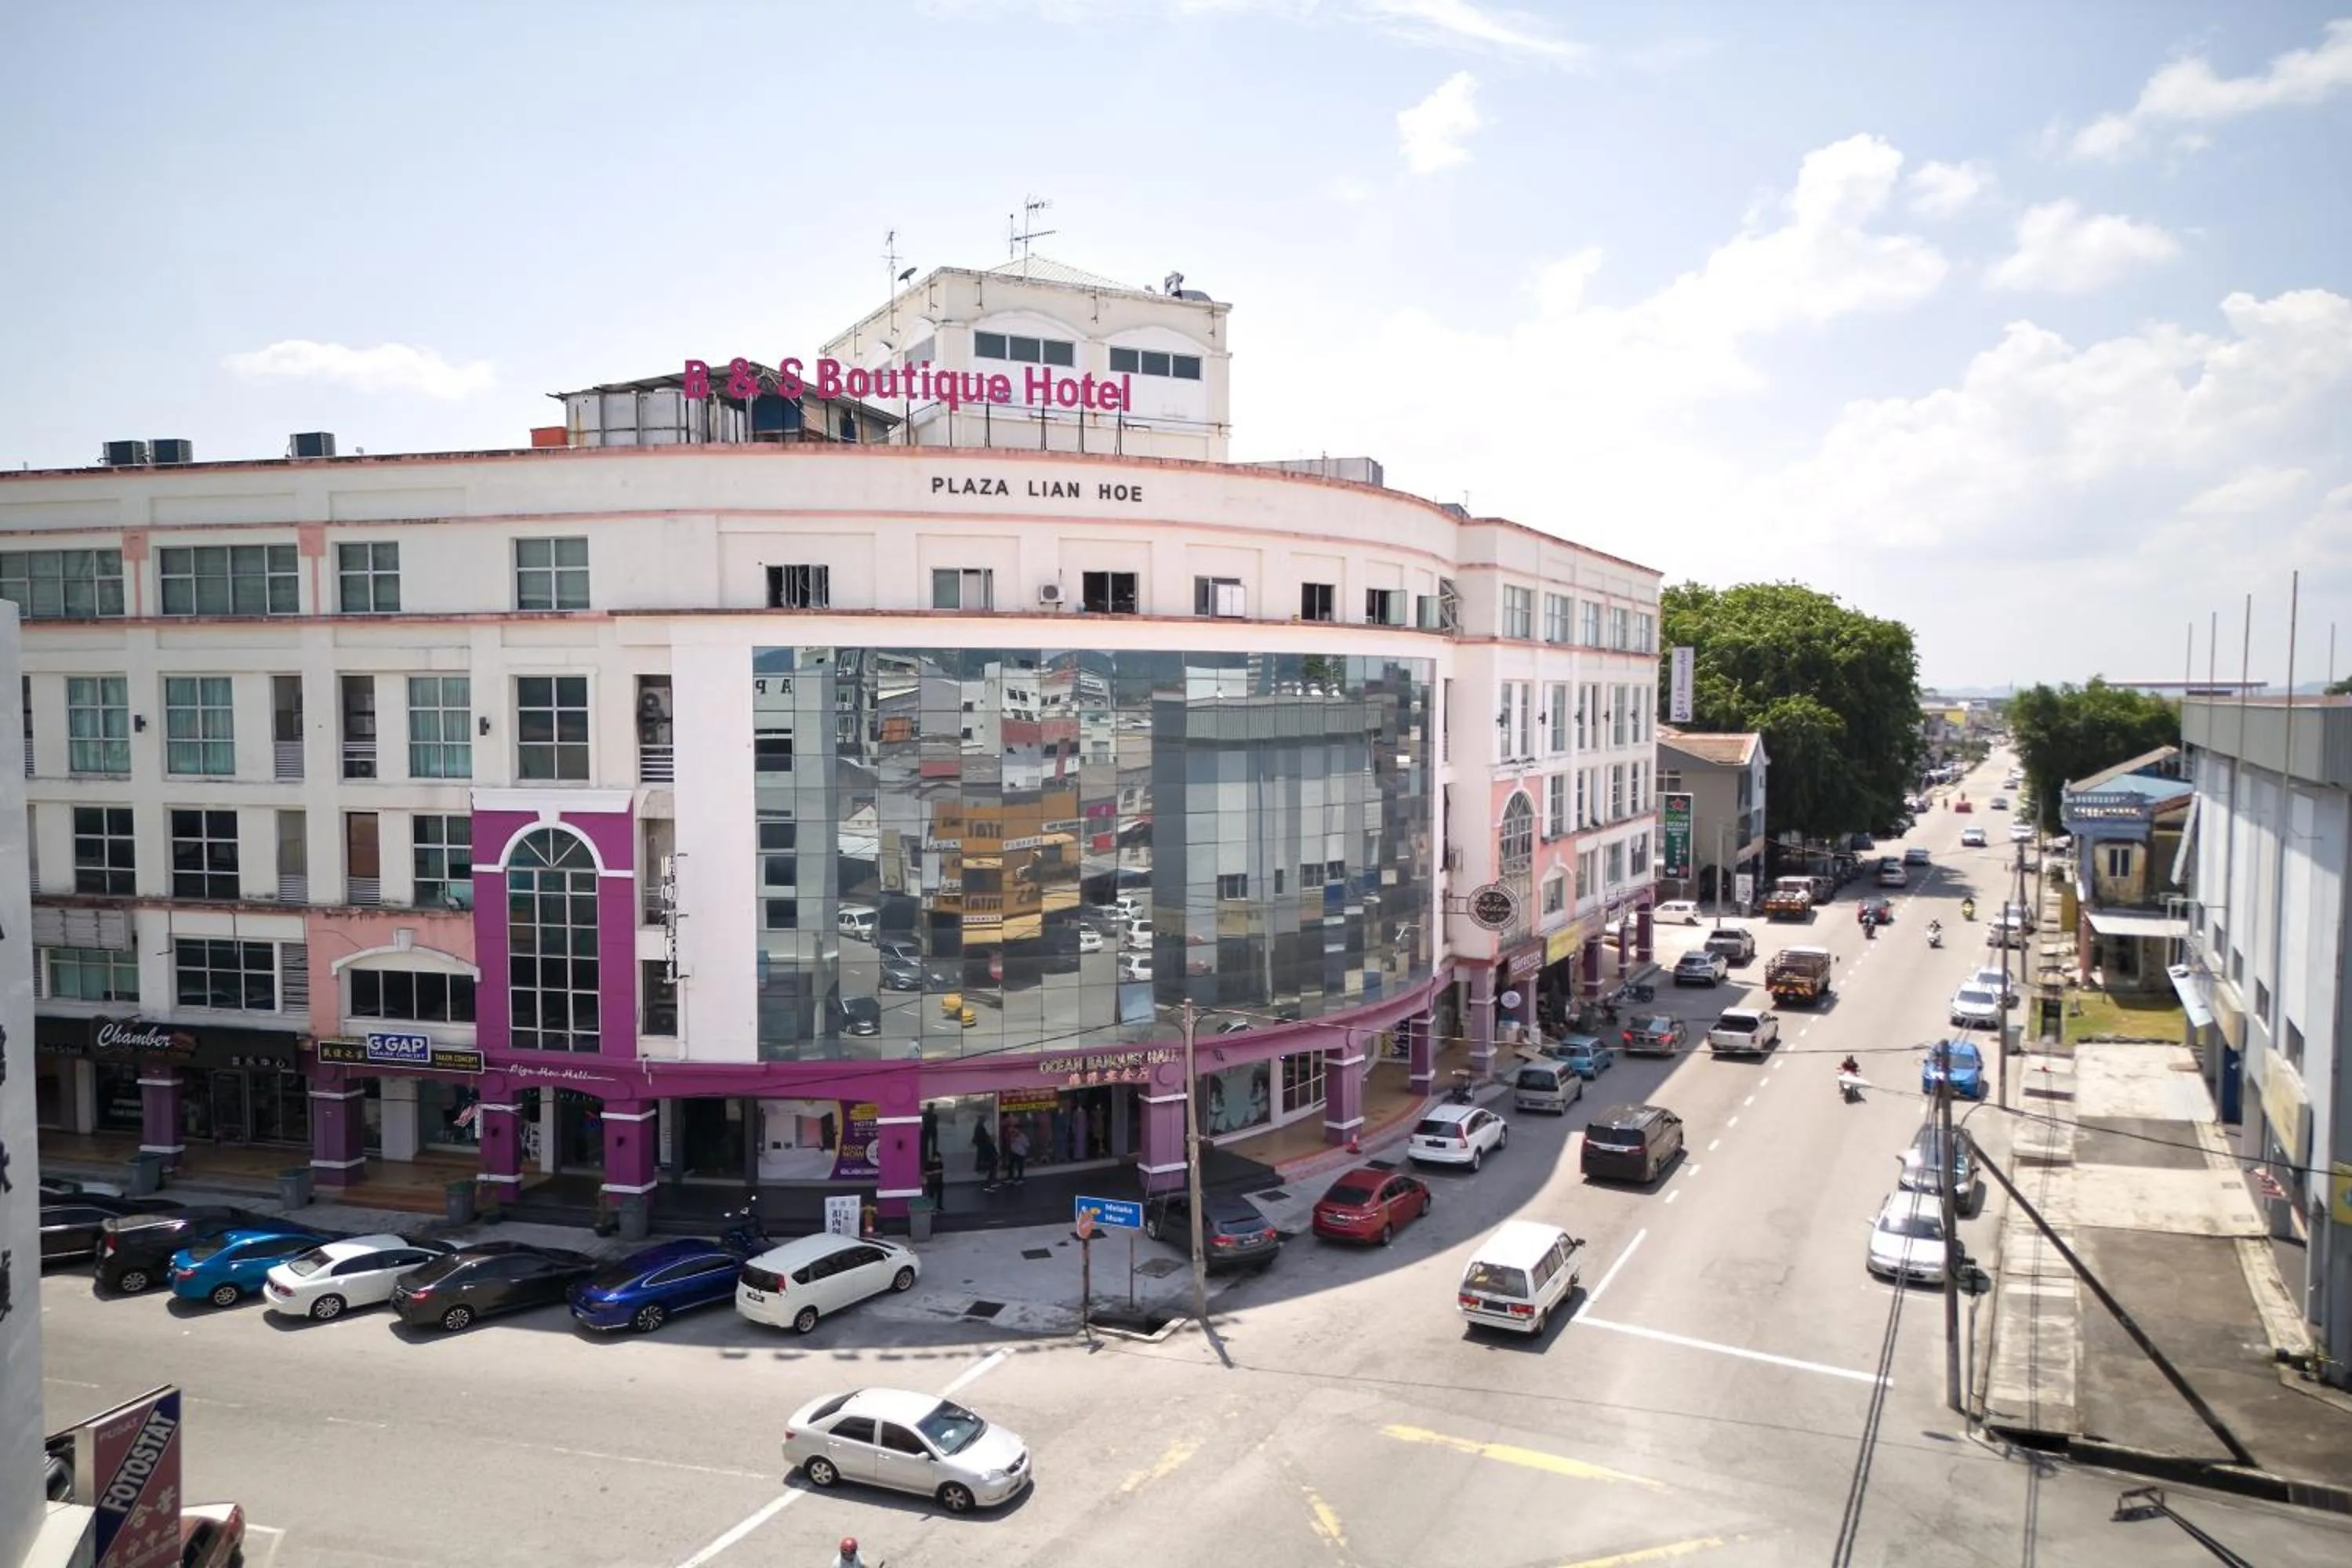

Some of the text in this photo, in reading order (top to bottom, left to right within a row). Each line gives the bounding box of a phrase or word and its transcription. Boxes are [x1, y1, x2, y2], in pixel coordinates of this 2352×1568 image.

[728, 357, 759, 398] &
[778, 357, 804, 399] S
[817, 358, 1011, 411] Boutique
[1025, 367, 1131, 412] Hotel
[931, 477, 1142, 503] PLAZA LIAN HOE
[97, 1023, 171, 1047] Chamber
[385, 1036, 426, 1053] GAP
[1040, 1058, 1083, 1074] OCEAN
[1148, 1049, 1180, 1064] HALL
[1105, 1203, 1133, 1214] Melaka
[100, 1410, 176, 1513] FOTOSTAT
